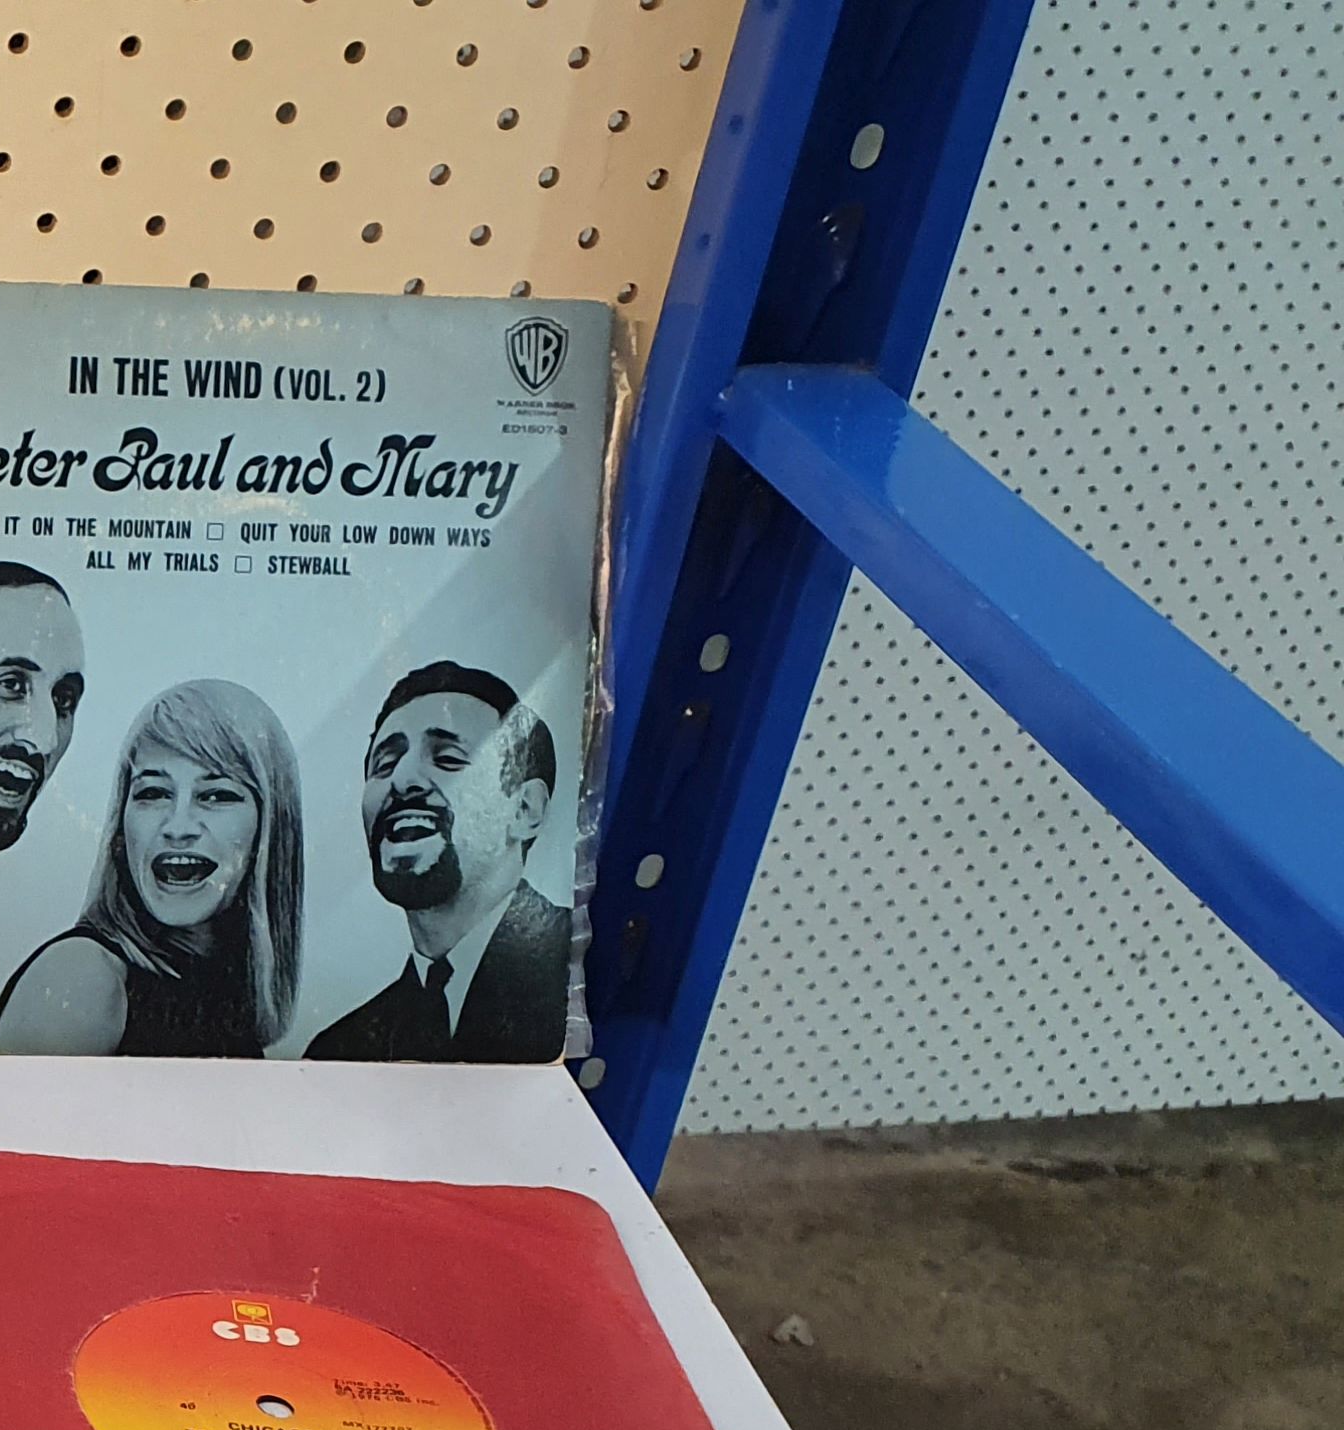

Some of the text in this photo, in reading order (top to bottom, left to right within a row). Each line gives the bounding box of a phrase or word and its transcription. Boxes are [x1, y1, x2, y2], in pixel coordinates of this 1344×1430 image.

[68, 356, 387, 404] IN THE WIND (VOL. 2)
[92, 426, 236, 493] Paul
[236, 436, 333, 495] and
[340, 434, 520, 519] Mary
[3, 516, 20, 536] IT
[31, 517, 54, 537] ON
[66, 517, 97, 538] THE
[107, 518, 192, 541] MOUNTAIN
[240, 522, 278, 544] QUIT
[288, 524, 332, 545] YOUR
[343, 524, 378, 546] LOW
[389, 525, 436, 547] DOWN
[446, 527, 492, 549] WAYS
[85, 549, 351, 577] ALL MY TRIALS STEWBALL
[212, 1321, 301, 1347] CBS
